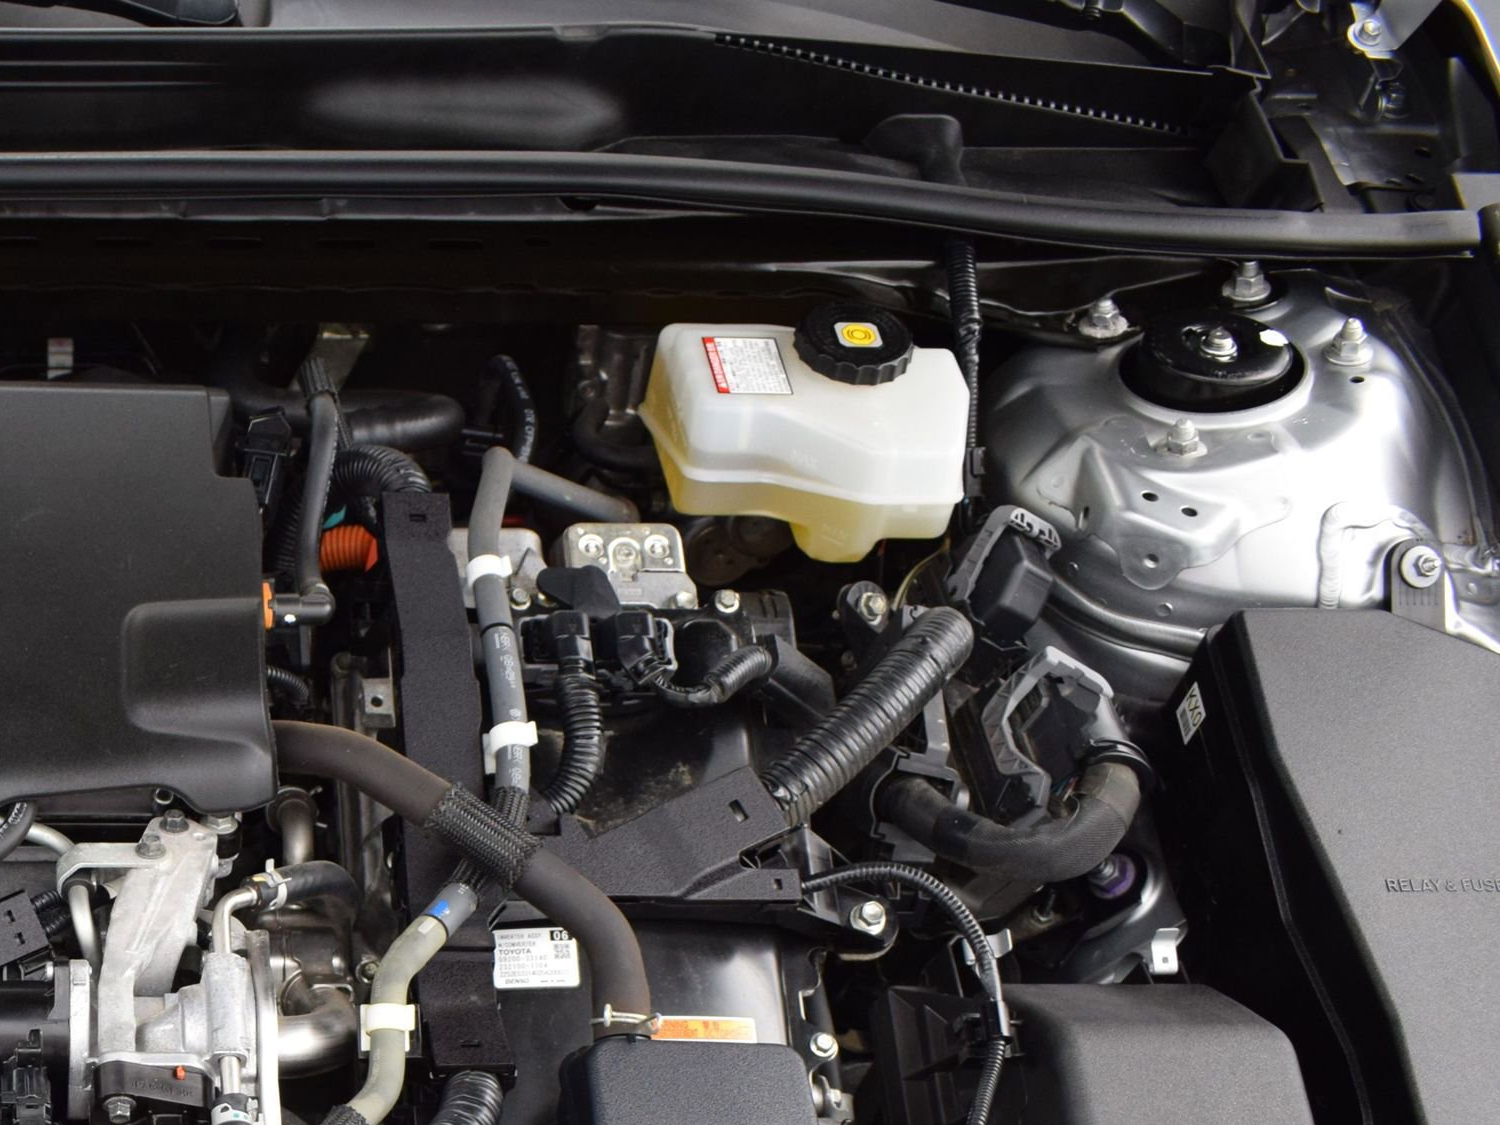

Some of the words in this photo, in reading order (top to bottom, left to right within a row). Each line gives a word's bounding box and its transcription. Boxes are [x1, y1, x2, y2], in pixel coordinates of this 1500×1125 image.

[1384, 878, 1440, 893] RELAY
[1445, 879, 1458, 893] &
[553, 930, 569, 940] 06
[499, 948, 532, 956] TOYOTA
